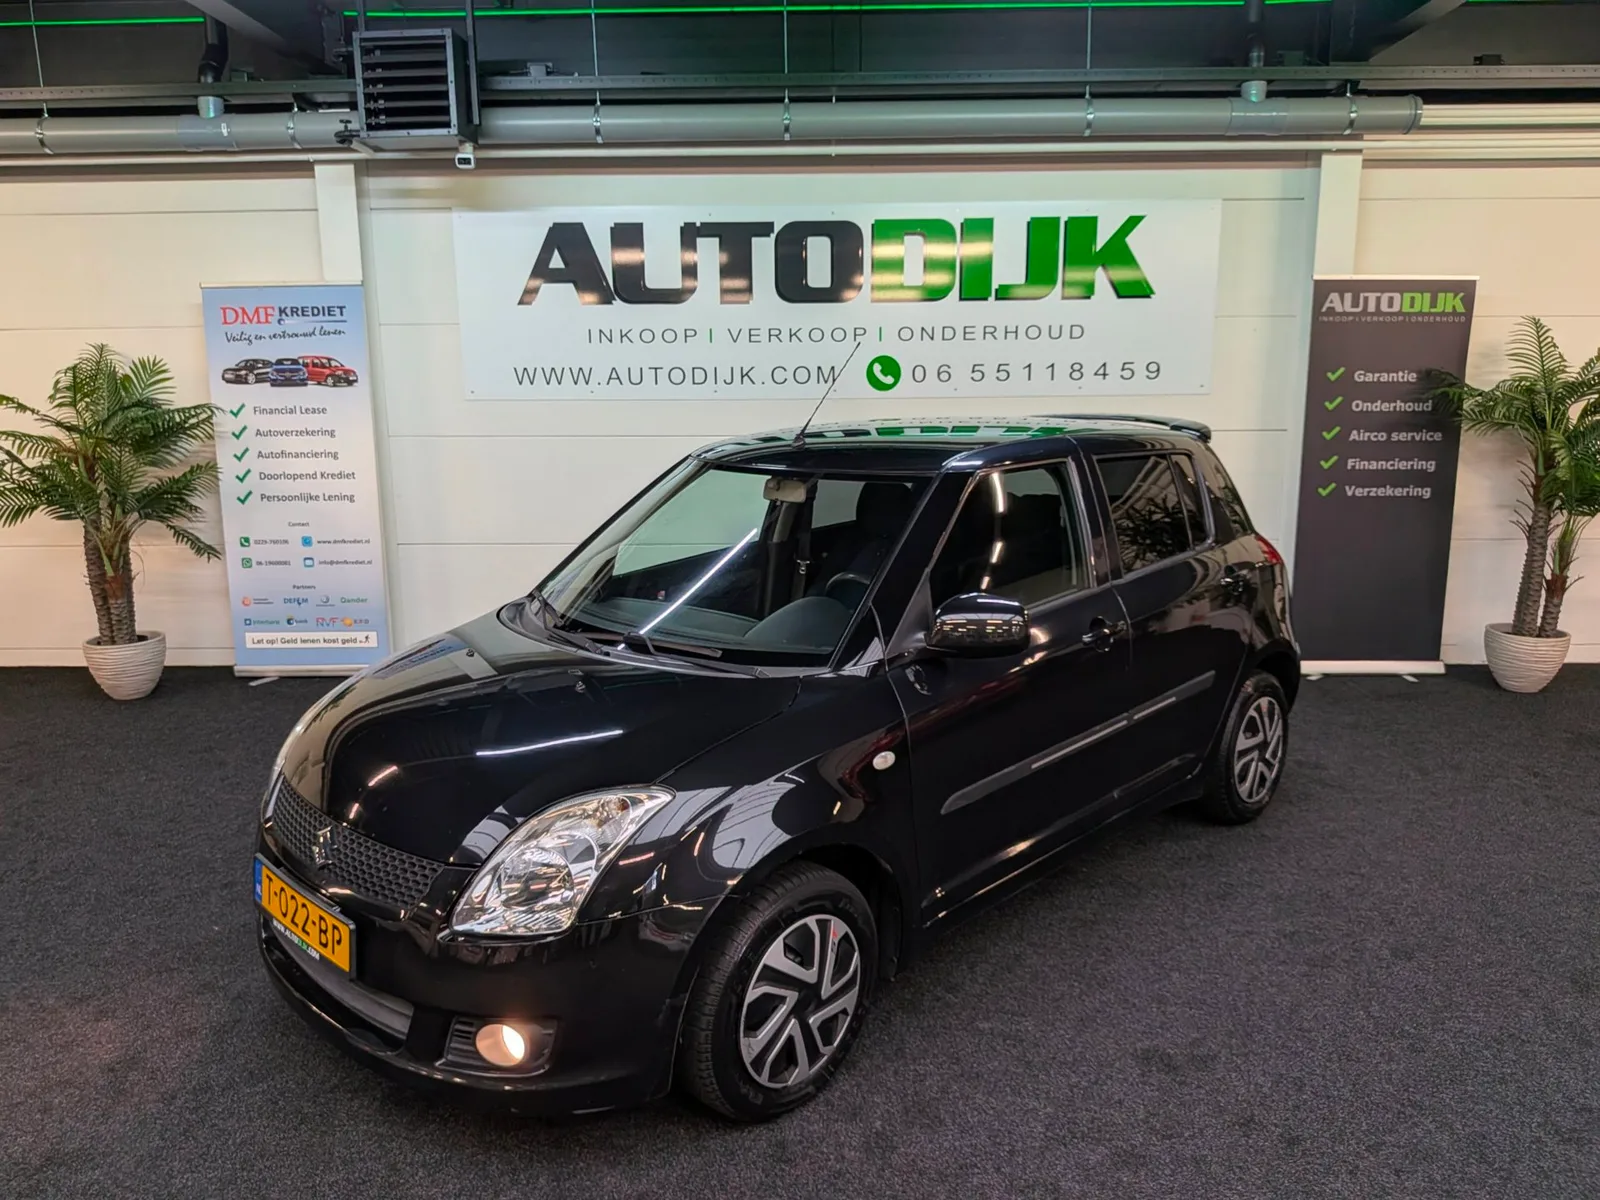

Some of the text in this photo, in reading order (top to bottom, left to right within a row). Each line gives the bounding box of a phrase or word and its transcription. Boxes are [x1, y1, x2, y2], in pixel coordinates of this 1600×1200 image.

[517, 214, 1156, 305] AUTODIJK
[1321, 292, 1466, 313] AUTODIJK
[220, 305, 346, 327] DMF KREDIET
[225, 331, 253, 346] Veilig
[254, 333, 266, 341] en
[318, 326, 346, 337] lenen
[588, 324, 1085, 344] INKOOP VERKOOP ONDERHOUD
[513, 365, 837, 386] WWW.AUTODIJK.COM
[911, 361, 1161, 383] 06 55118459
[1354, 370, 1417, 383] Garantie
[253, 405, 328, 415] Financial Lease
[1351, 400, 1432, 412] Onderhoud
[255, 427, 336, 438] Autoverzekering
[1349, 430, 1443, 442] Airco service
[257, 449, 339, 461] Autofinanciering
[1347, 458, 1436, 473] Financiering
[259, 471, 356, 482] Doorlopend Krediet
[260, 492, 355, 503] Persoonlijke Lening
[1345, 485, 1431, 499] Verzekering
[252, 637, 264, 645] Let
[266, 637, 278, 646] op!
[280, 636, 298, 645] Geld
[300, 636, 321, 644] lenen
[323, 636, 339, 644] kost
[341, 636, 358, 645] geld
[266, 874, 342, 955] T-022-BP
